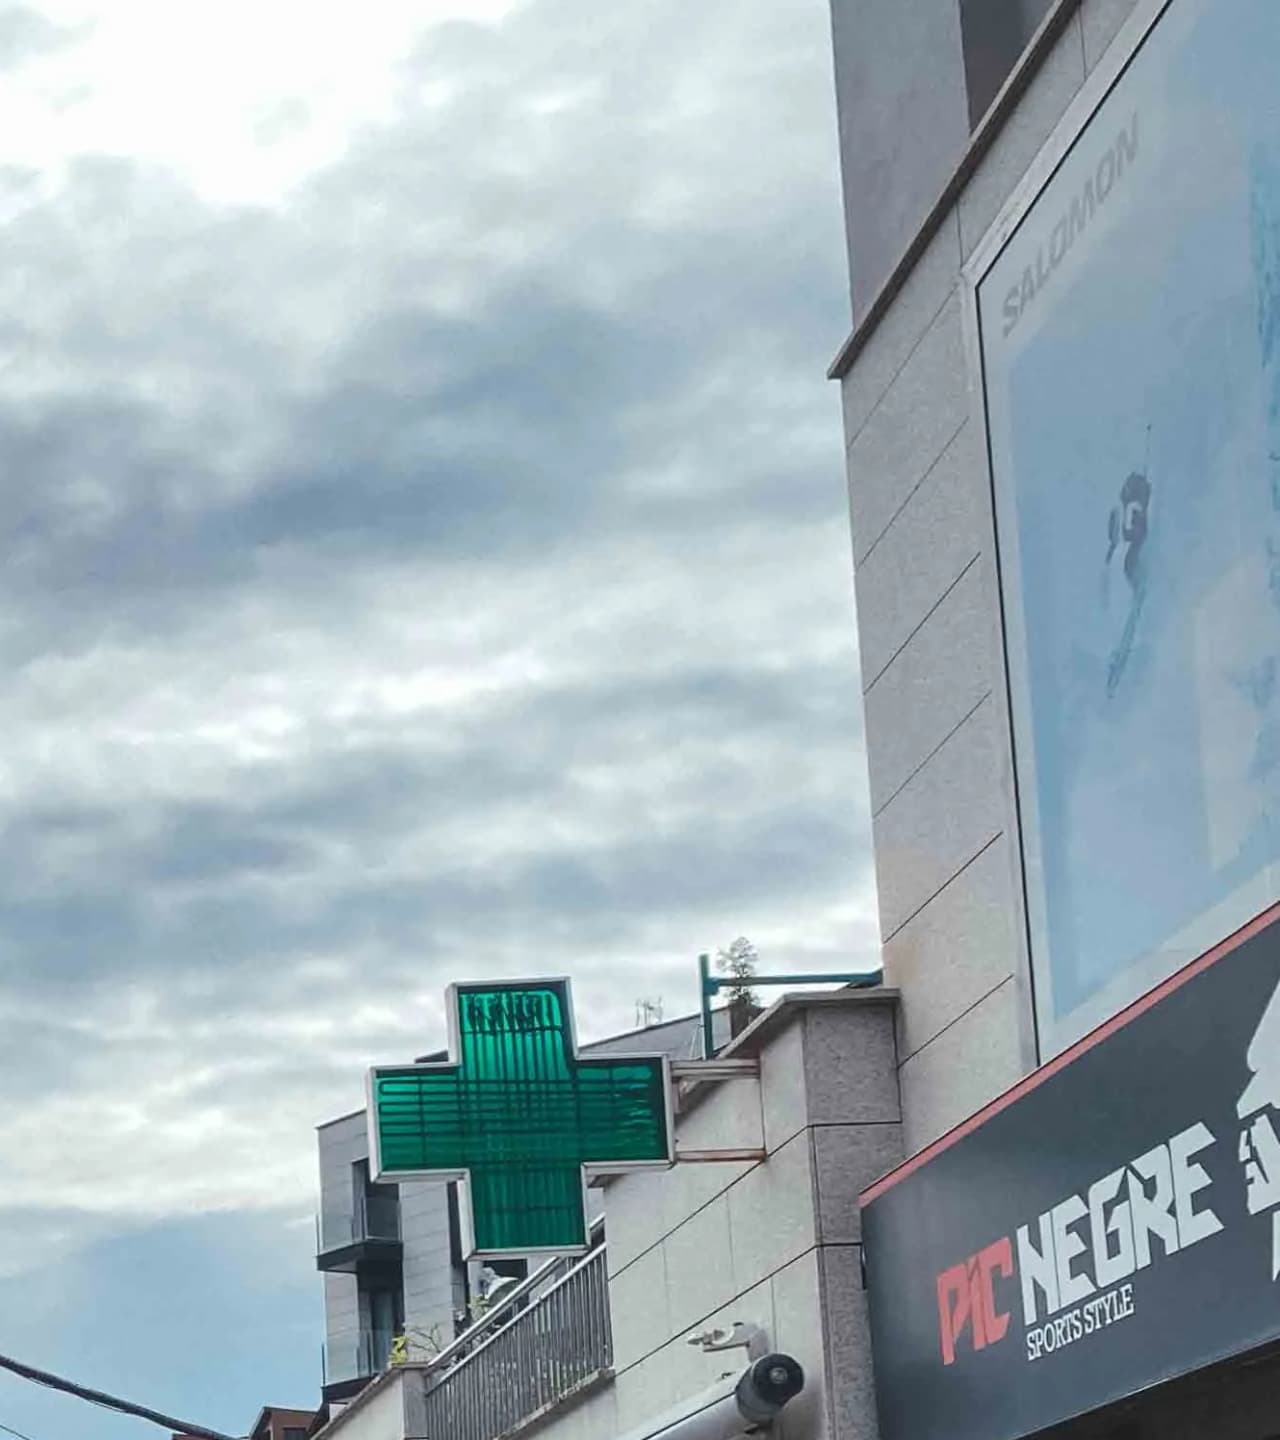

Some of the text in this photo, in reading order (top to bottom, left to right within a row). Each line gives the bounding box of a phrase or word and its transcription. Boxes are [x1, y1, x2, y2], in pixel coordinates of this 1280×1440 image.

[1002, 109, 1139, 338] SALOMON
[1016, 1121, 1225, 1326] NEGRE
[1026, 1283, 1134, 1361] SPORTS STYLE
